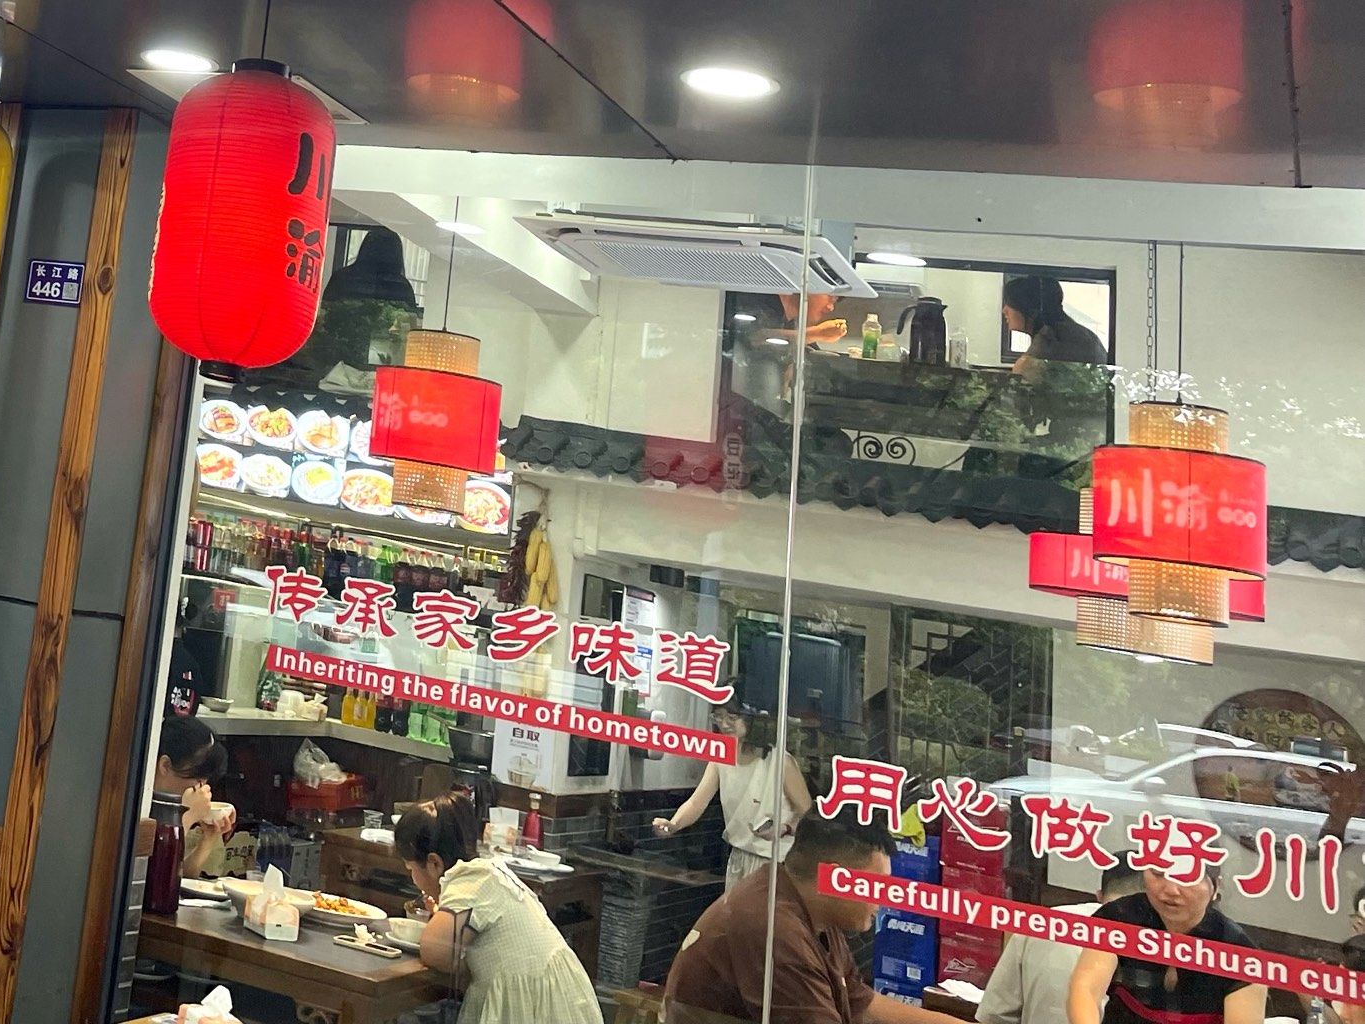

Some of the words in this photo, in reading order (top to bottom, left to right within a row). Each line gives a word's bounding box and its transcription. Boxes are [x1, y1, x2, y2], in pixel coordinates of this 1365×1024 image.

[32, 281, 61, 297] 446
[266, 566, 735, 704] 传承家乡味道
[274, 646, 395, 695] Inheriting
[401, 675, 443, 702] the
[450, 683, 529, 719] flavor
[535, 701, 563, 725] of
[569, 706, 727, 759] hometown
[817, 756, 1365, 914] 用心做好川
[831, 866, 982, 925] Carefully
[991, 904, 1127, 950] prepare
[1137, 928, 1288, 984] Sichuan
